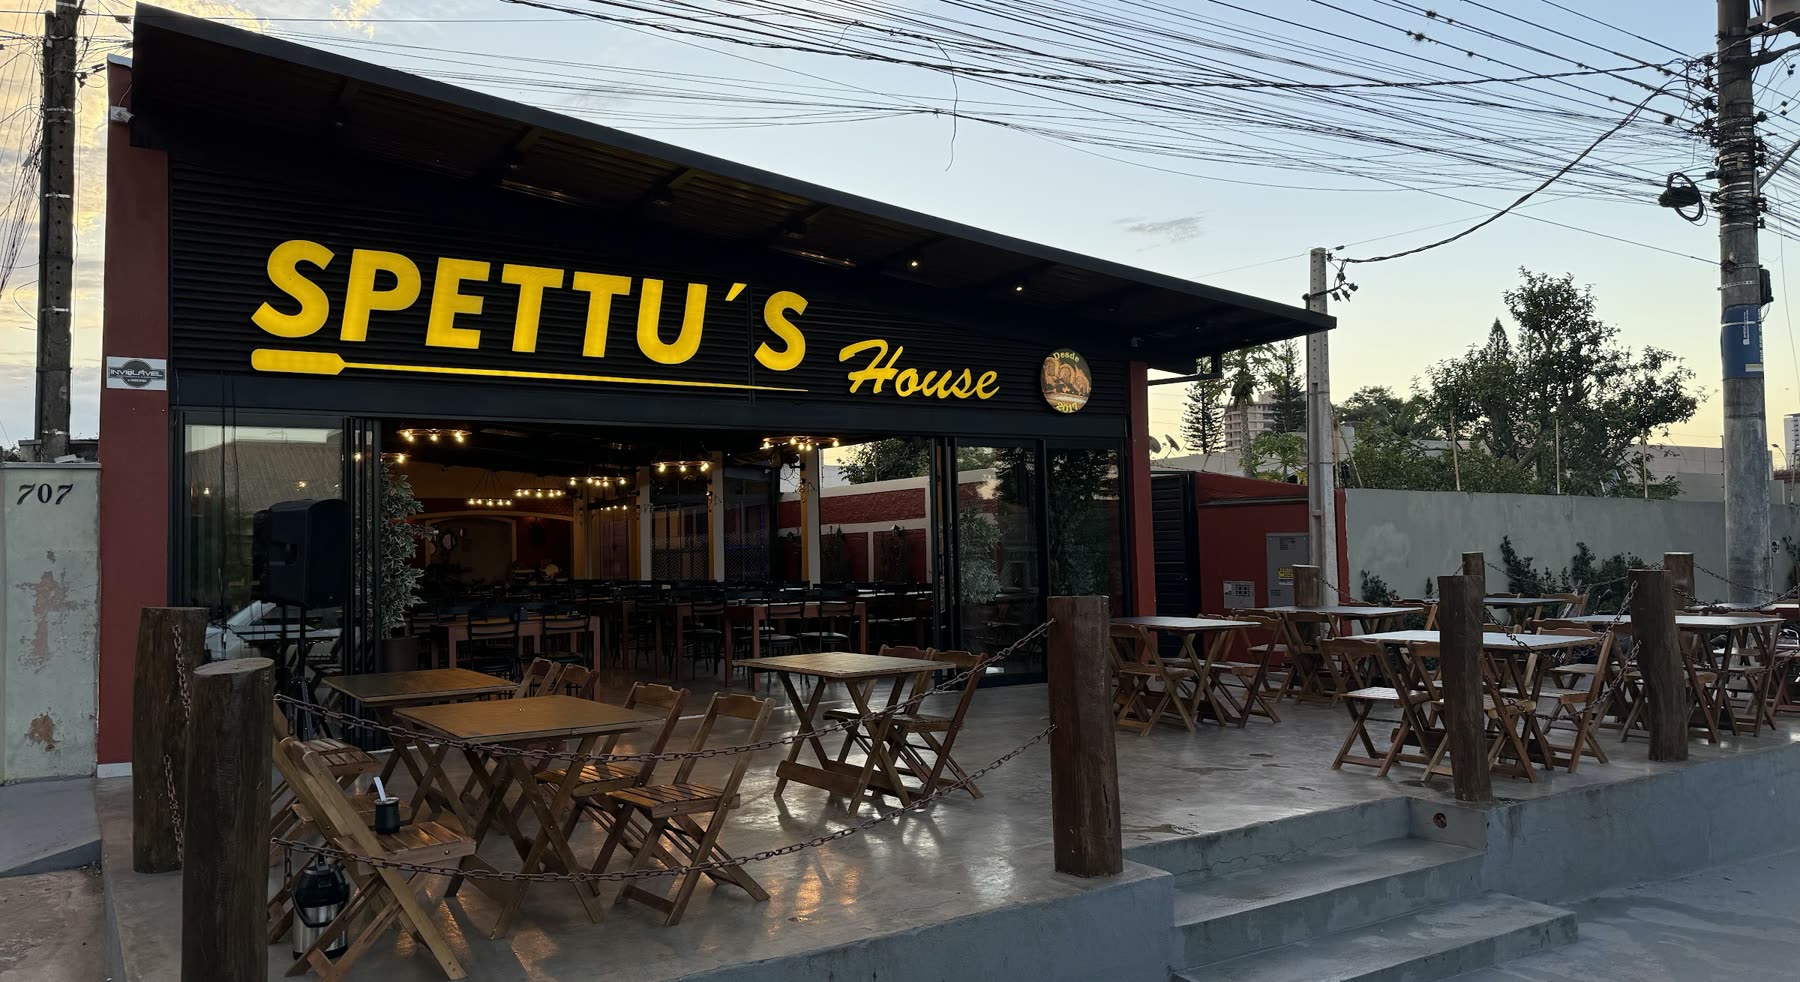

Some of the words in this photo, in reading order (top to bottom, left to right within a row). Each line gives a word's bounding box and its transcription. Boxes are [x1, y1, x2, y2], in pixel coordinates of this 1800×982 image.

[1052, 351, 1080, 363] Desde
[838, 338, 1000, 400] House
[17, 483, 74, 505] 707
